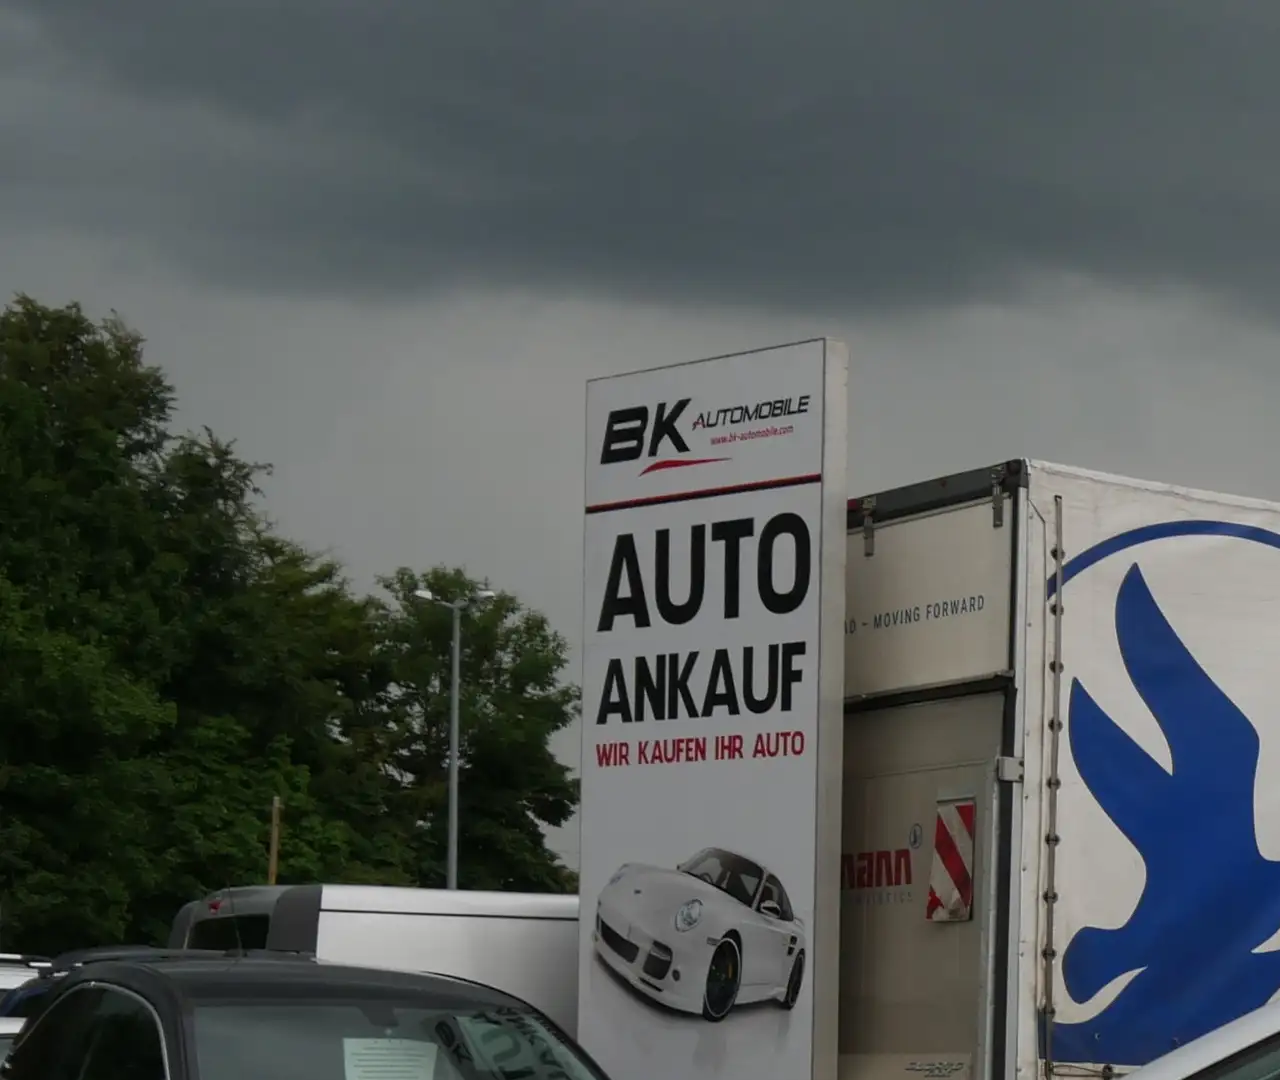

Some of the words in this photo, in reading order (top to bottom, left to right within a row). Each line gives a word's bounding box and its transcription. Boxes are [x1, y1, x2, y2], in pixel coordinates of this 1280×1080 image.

[600, 398, 692, 464] BK
[691, 394, 811, 430] AUTOMOBILE
[596, 511, 812, 632] AUTO
[873, 606, 921, 630] MOVING
[926, 594, 985, 621] FORWARD
[596, 641, 807, 725] ANKAUF
[596, 741, 631, 767] WIR
[637, 736, 707, 765] KAUFEN
[714, 734, 744, 761] IHR
[752, 731, 806, 758] AUTO
